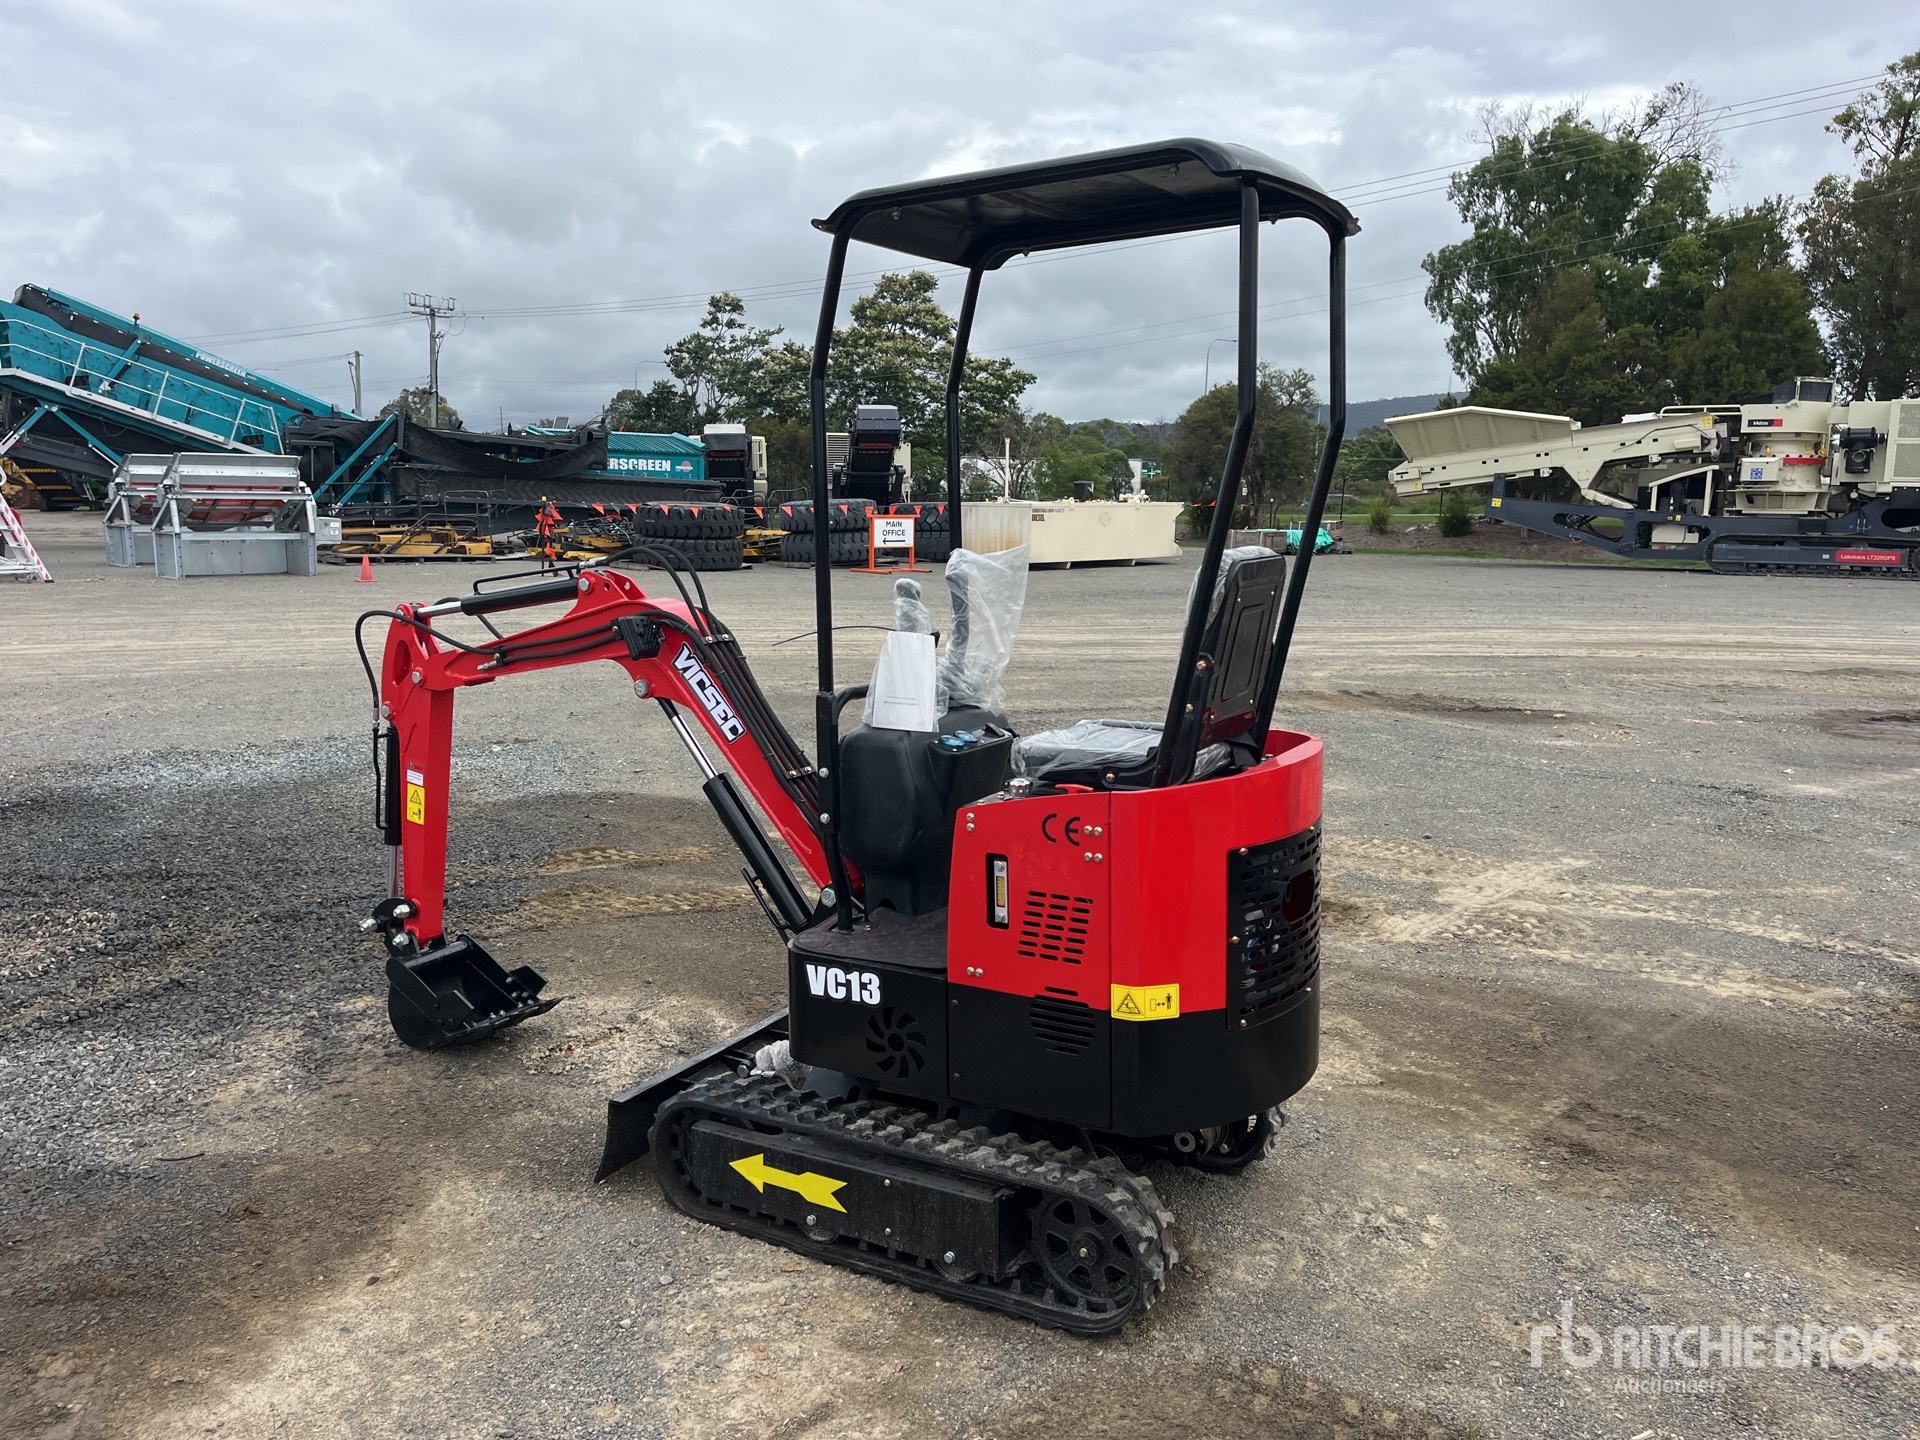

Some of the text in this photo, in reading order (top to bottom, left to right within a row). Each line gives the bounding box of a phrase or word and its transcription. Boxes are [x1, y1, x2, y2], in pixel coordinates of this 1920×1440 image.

[195, 351, 247, 378] POWERSCREEN
[607, 458, 671, 472] RSCREEN
[885, 520, 903, 528] MAIN
[1031, 514, 1045, 522] DIESEL
[882, 529, 906, 537] OFFICE
[1041, 813, 1081, 847] CE
[805, 963, 881, 1005] VC13
